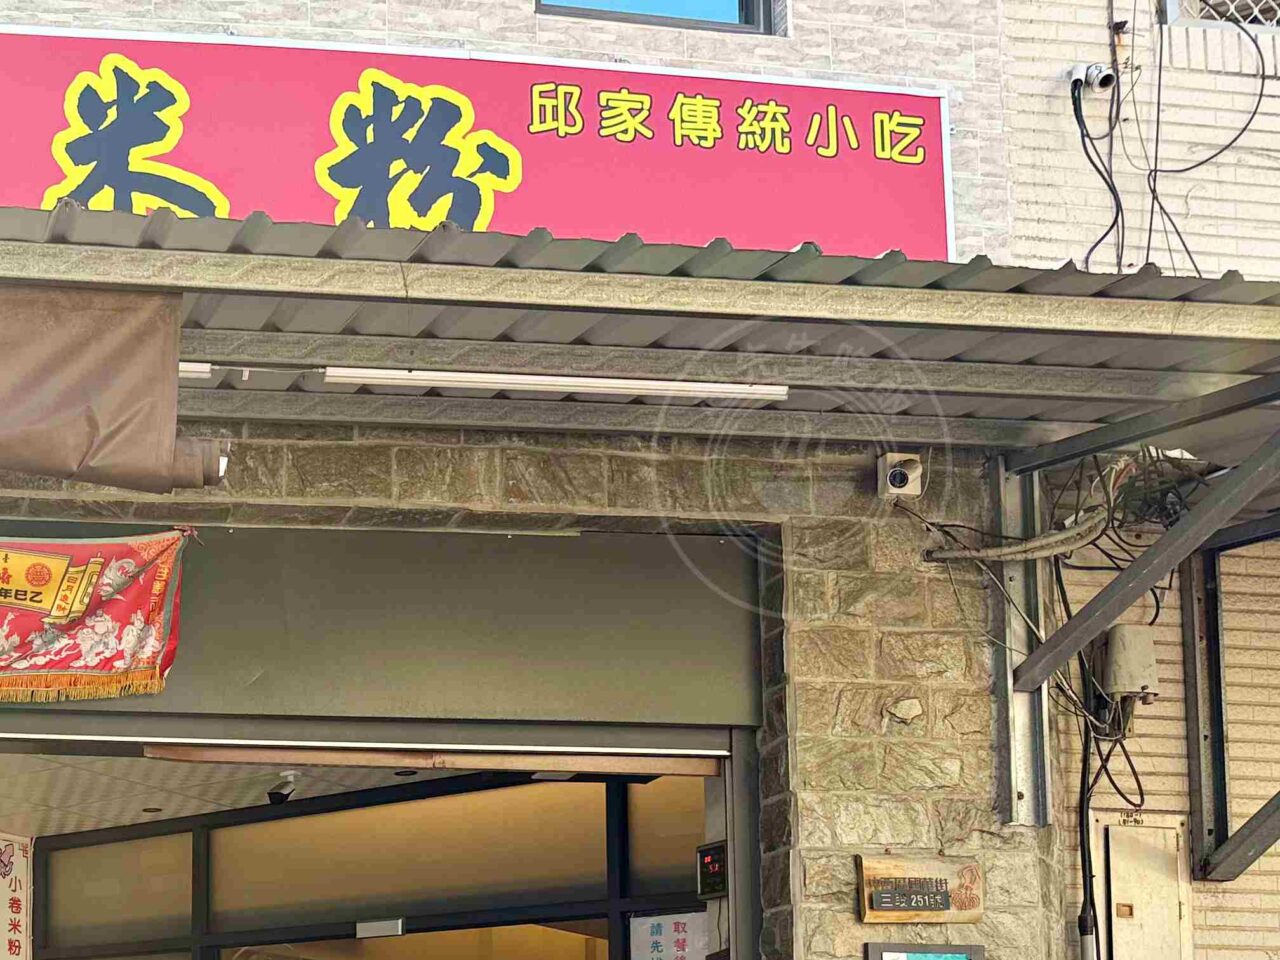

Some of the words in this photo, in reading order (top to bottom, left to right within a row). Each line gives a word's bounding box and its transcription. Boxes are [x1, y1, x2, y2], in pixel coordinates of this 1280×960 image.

[527, 80, 928, 166] 邱家傳統小吃
